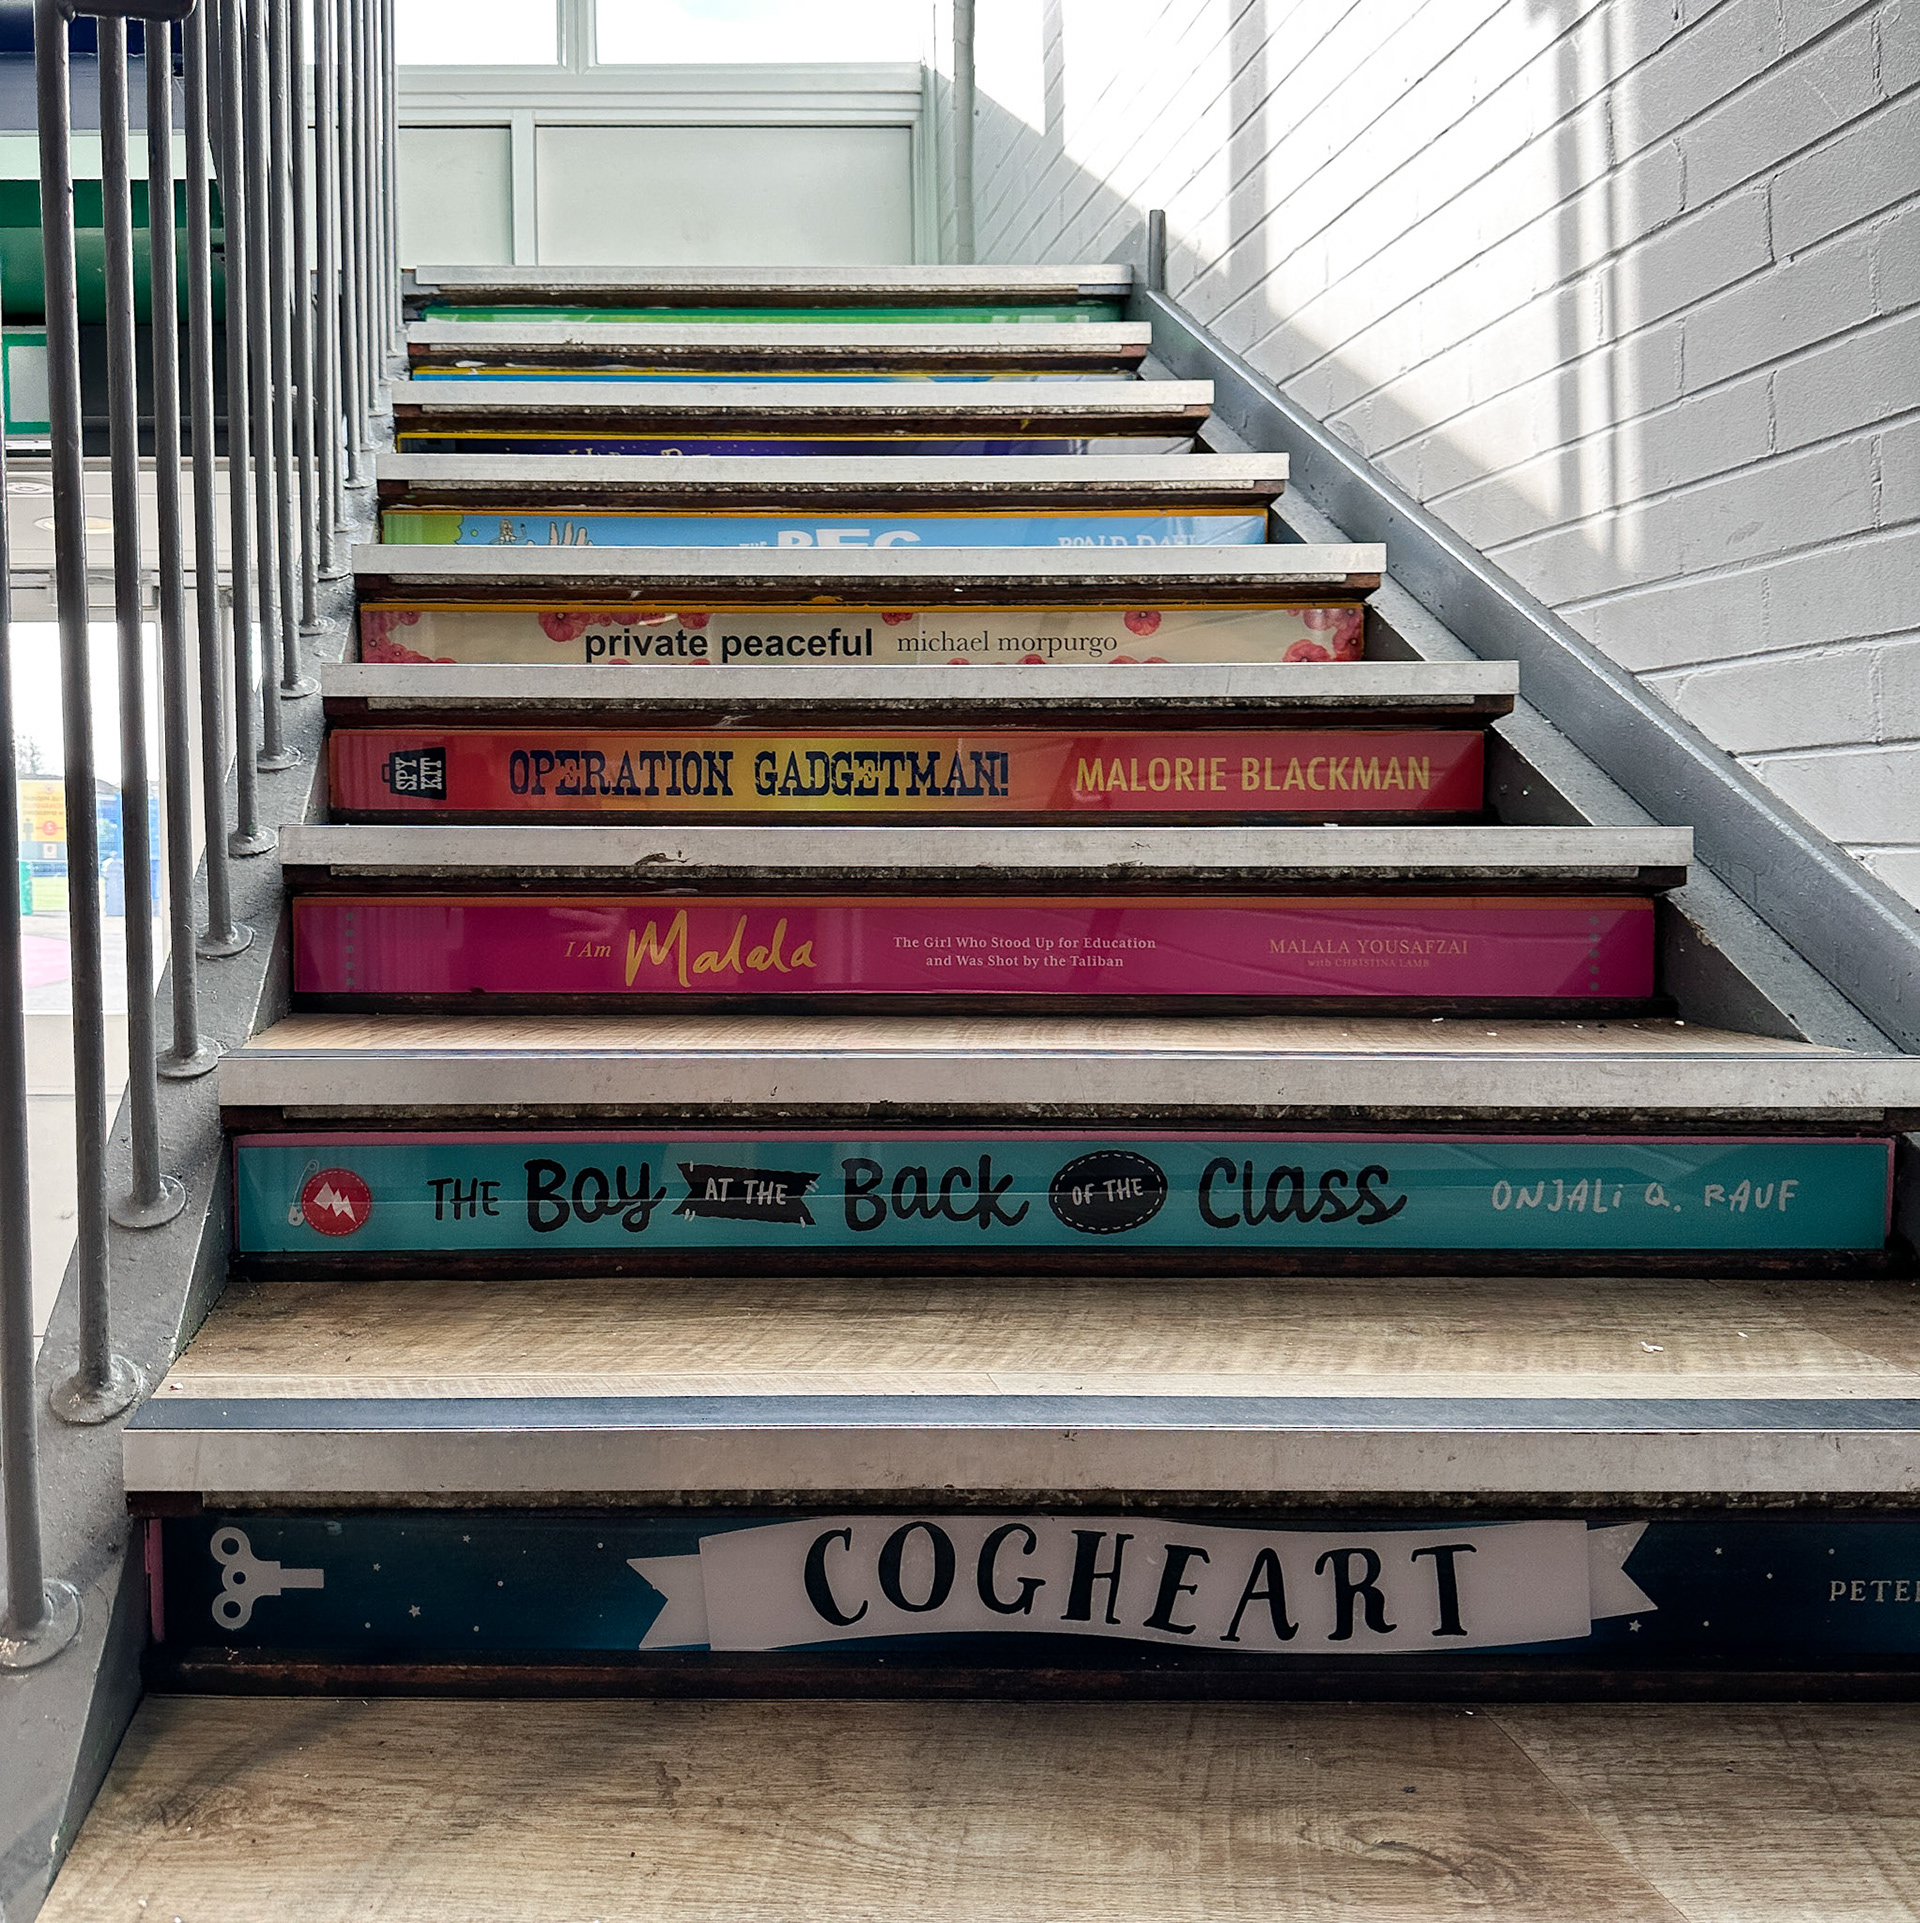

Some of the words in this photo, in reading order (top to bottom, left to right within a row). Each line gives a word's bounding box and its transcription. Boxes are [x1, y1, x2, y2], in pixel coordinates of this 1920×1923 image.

[585, 628, 708, 663] private
[721, 628, 873, 663] peaceful
[897, 630, 990, 652] michael
[998, 635, 1118, 658] morpurgo
[395, 757, 418, 790] SPY
[420, 758, 442, 790] KIT
[509, 749, 734, 797] OPERATION
[754, 750, 1009, 797] GADGETMAN!
[1076, 757, 1227, 792] MALORIE
[1241, 756, 1431, 791] BLACKMAN
[563, 941, 576, 958] I
[578, 941, 612, 958] Am
[624, 909, 817, 988] Malala
[893, 936, 919, 948] The
[924, 936, 951, 948] Girl
[956, 936, 987, 948] Who
[991, 936, 1030, 949] Stood
[1035, 936, 1054, 951] Up
[1058, 936, 1079, 949] for
[1083, 936, 1156, 949] Education
[1269, 939, 1350, 954] MALALA
[1356, 939, 1468, 955] YOUSAFZAI
[926, 955, 952, 967] and
[956, 955, 984, 967] Was
[987, 955, 1019, 967] Shot
[1023, 955, 1037, 969] by
[1043, 955, 1066, 967] the
[1070, 955, 1124, 967] Taliban
[1307, 958, 1331, 967] with
[1335, 958, 1396, 968] CHRISTINA
[1399, 958, 1430, 968] LAMB
[427, 1177, 501, 1221] THE
[523, 1158, 669, 1233] Boy
[705, 1178, 730, 1203] AT
[744, 1179, 787, 1206] THE
[841, 1153, 1030, 1232] Back
[1071, 1185, 1094, 1206] OF
[1101, 1177, 1144, 1203] THE
[1198, 1156, 1408, 1230] Class
[1644, 1181, 1682, 1213] Q.
[803, 1520, 1478, 1642] COGHEART
[1829, 1580, 1920, 1602] PETE
